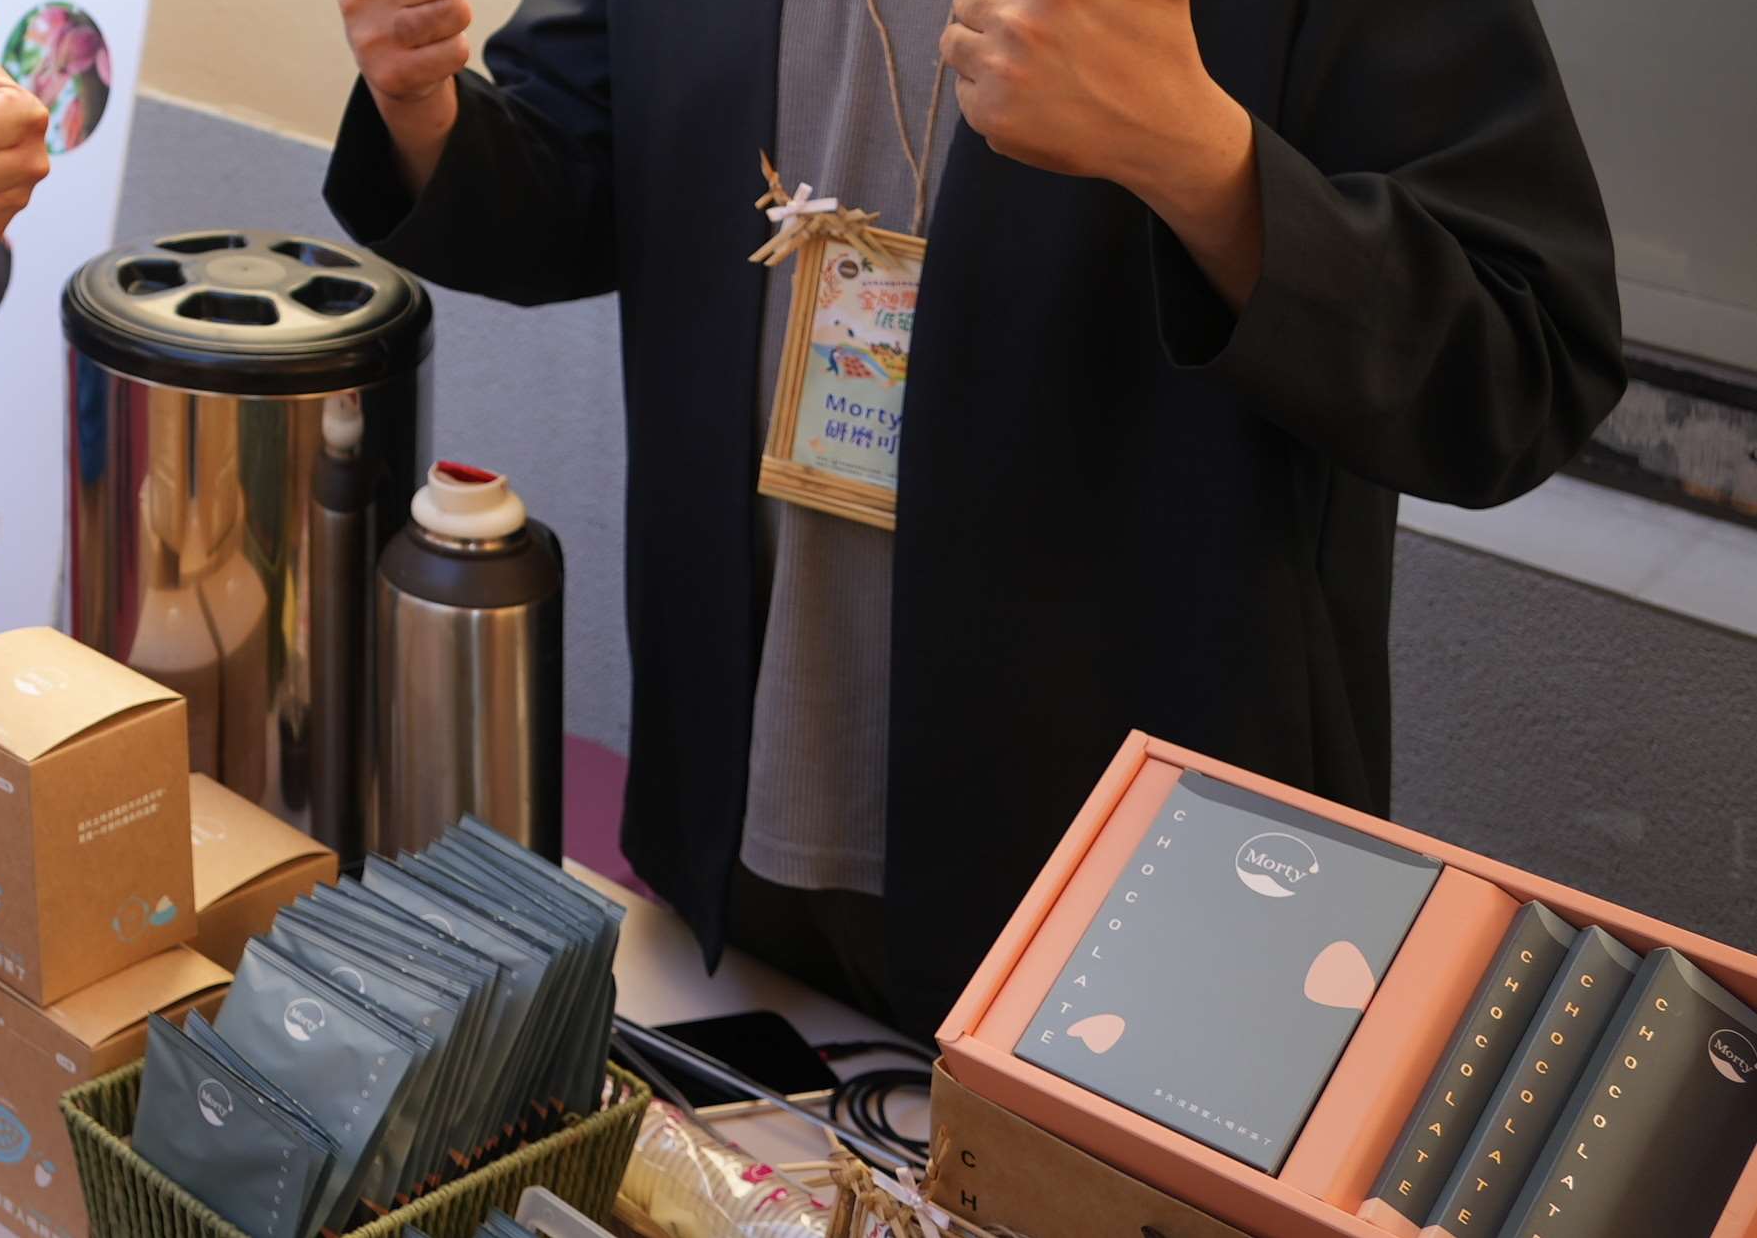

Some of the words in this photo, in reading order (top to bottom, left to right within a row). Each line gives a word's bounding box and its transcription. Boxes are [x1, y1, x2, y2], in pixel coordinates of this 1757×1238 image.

[825, 393, 903, 430] Morty
[1040, 809, 1187, 1044] CHOCOLATE
[1244, 848, 1307, 883] Morty
[1398, 950, 1533, 1197] CHOCOLATE
[1457, 974, 1594, 1226] CHOCOLATE
[1531, 997, 1669, 1238] CHOCOLAT
[1713, 1038, 1754, 1075] Morty
